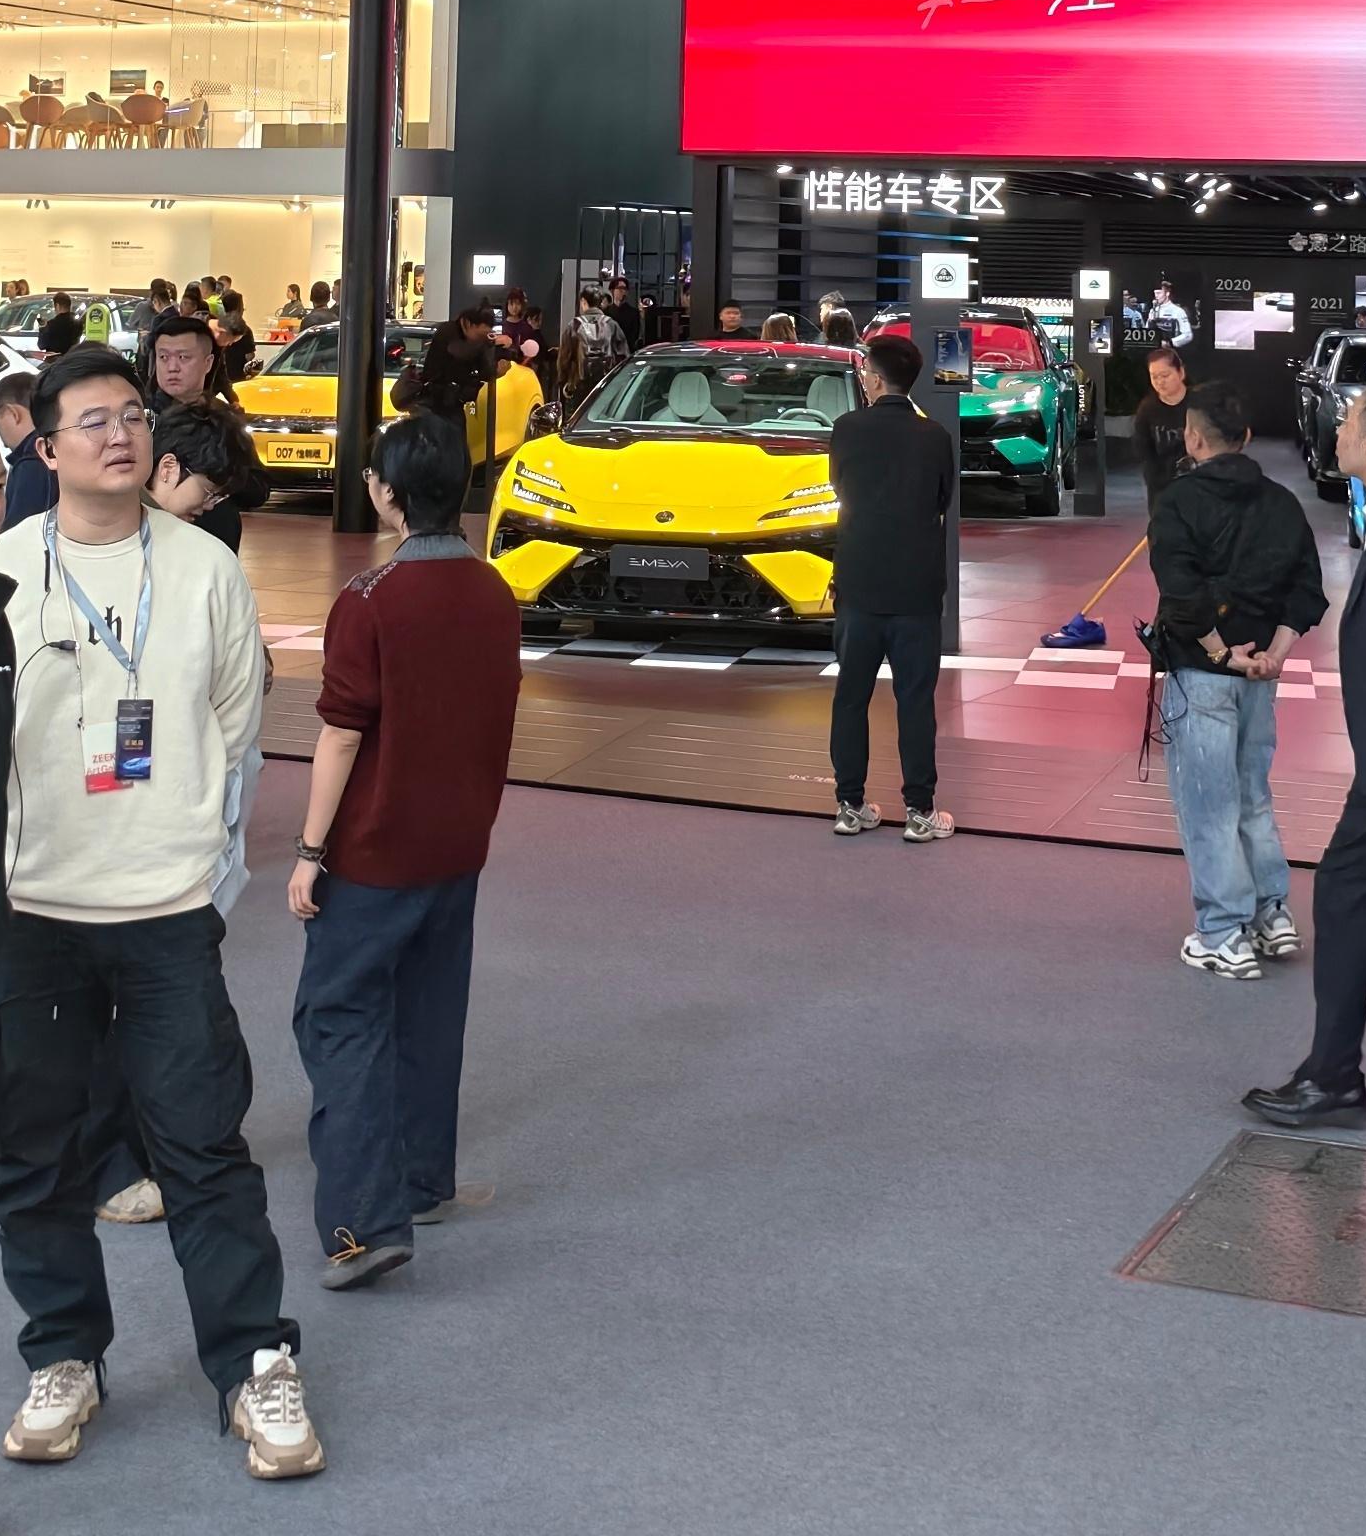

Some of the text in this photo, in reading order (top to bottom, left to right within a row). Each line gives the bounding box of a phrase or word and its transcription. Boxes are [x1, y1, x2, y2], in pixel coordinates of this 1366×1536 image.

[804, 170, 1006, 215] 性能车专区
[478, 265, 496, 275] 007
[1215, 279, 1251, 291] 2020
[1310, 297, 1344, 310] 2021
[1123, 329, 1156, 341] 2019
[275, 447, 294, 459] 007
